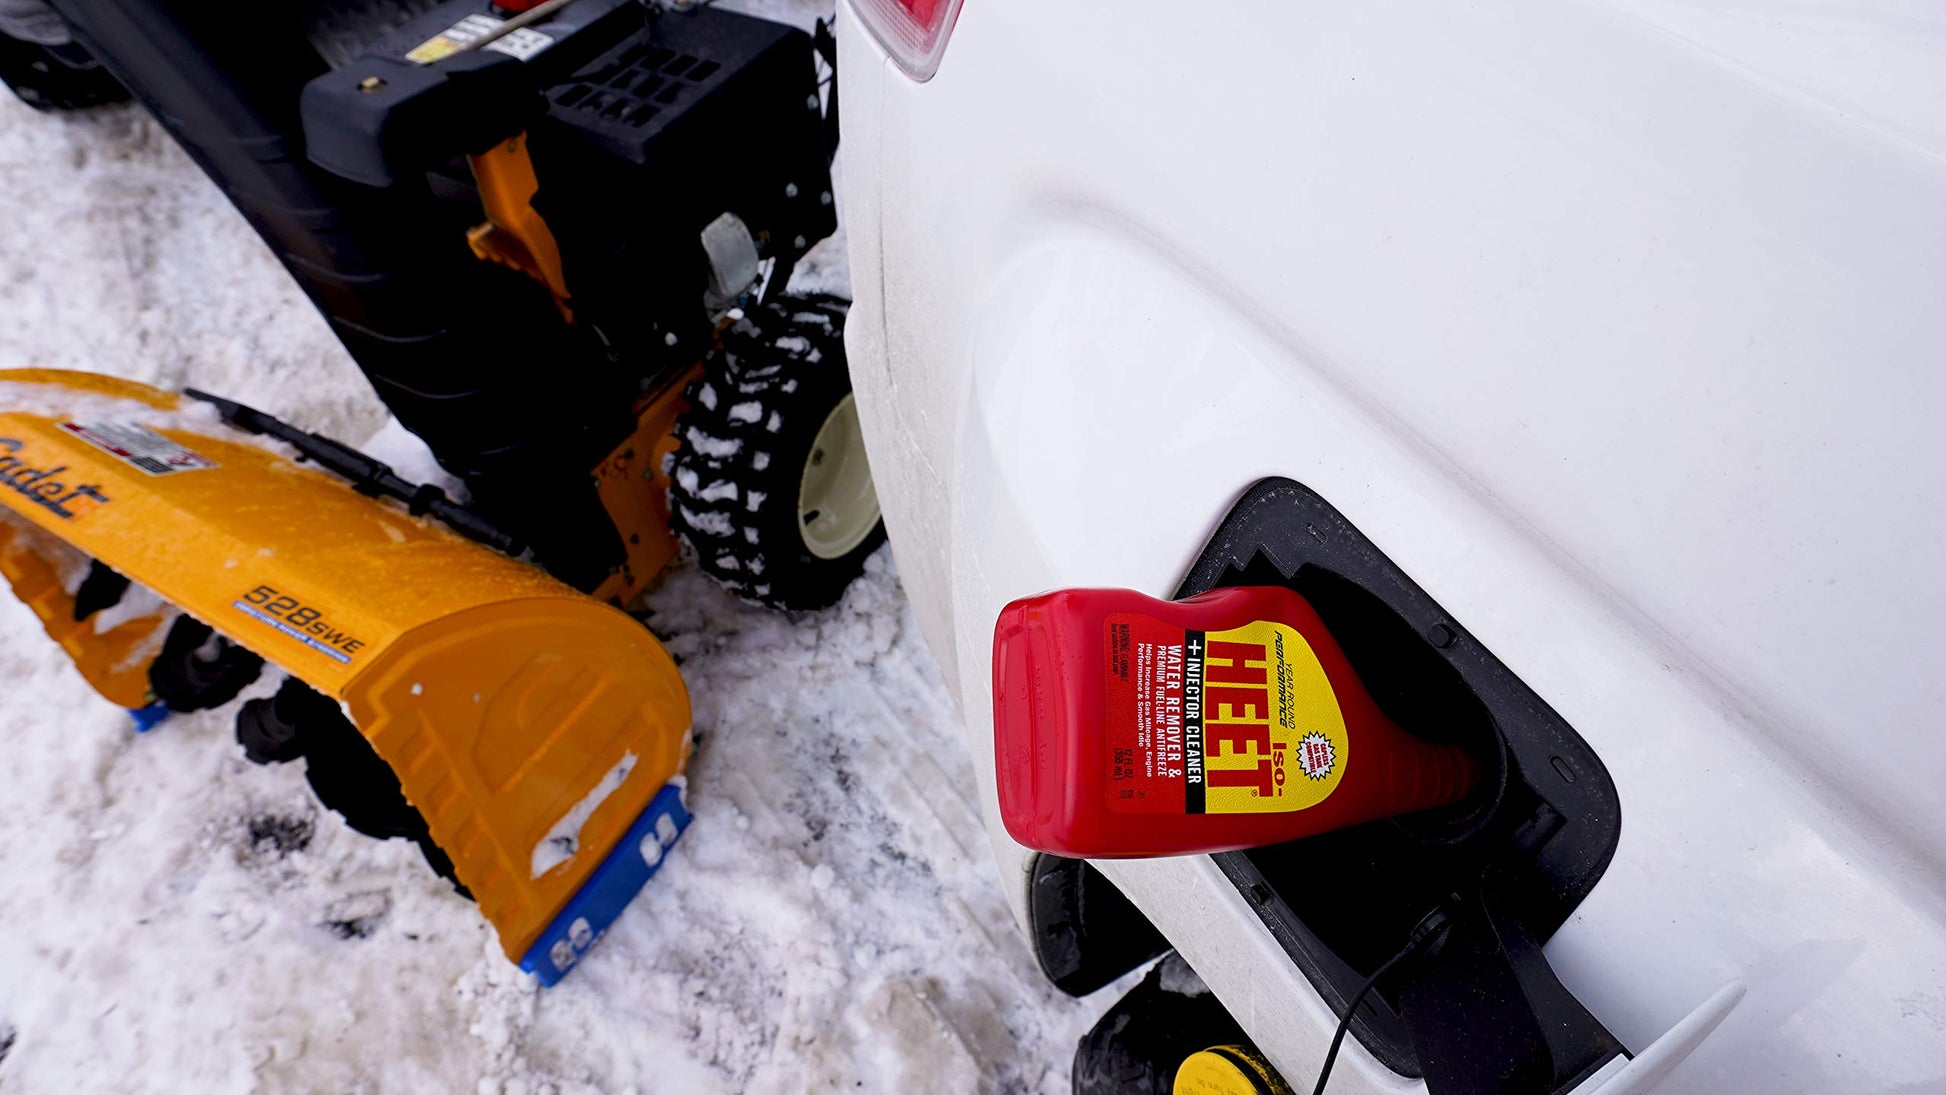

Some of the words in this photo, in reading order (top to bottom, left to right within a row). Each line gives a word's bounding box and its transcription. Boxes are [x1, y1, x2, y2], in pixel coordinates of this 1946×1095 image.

[1137, 643, 1145, 692] Performance
[1144, 644, 1152, 664] Helps
[1156, 645, 1166, 682] PREMIUM
[1166, 645, 1182, 689] WATER
[1274, 630, 1288, 728] PERFORMANCE
[1286, 662, 1294, 690] YEAR
[1156, 686, 1165, 724] FUEL-LINE
[1204, 640, 1274, 797] HEET
[1287, 692, 1296, 730] ROUND
[1144, 718, 1152, 749] Mileage,
[1166, 697, 1181, 761] REMOVER
[1144, 751, 1152, 778] Engine
[1156, 728, 1167, 776] ANTIFREEZE
[1186, 726, 1202, 784] CLEANER
[1168, 768, 1182, 778] &
